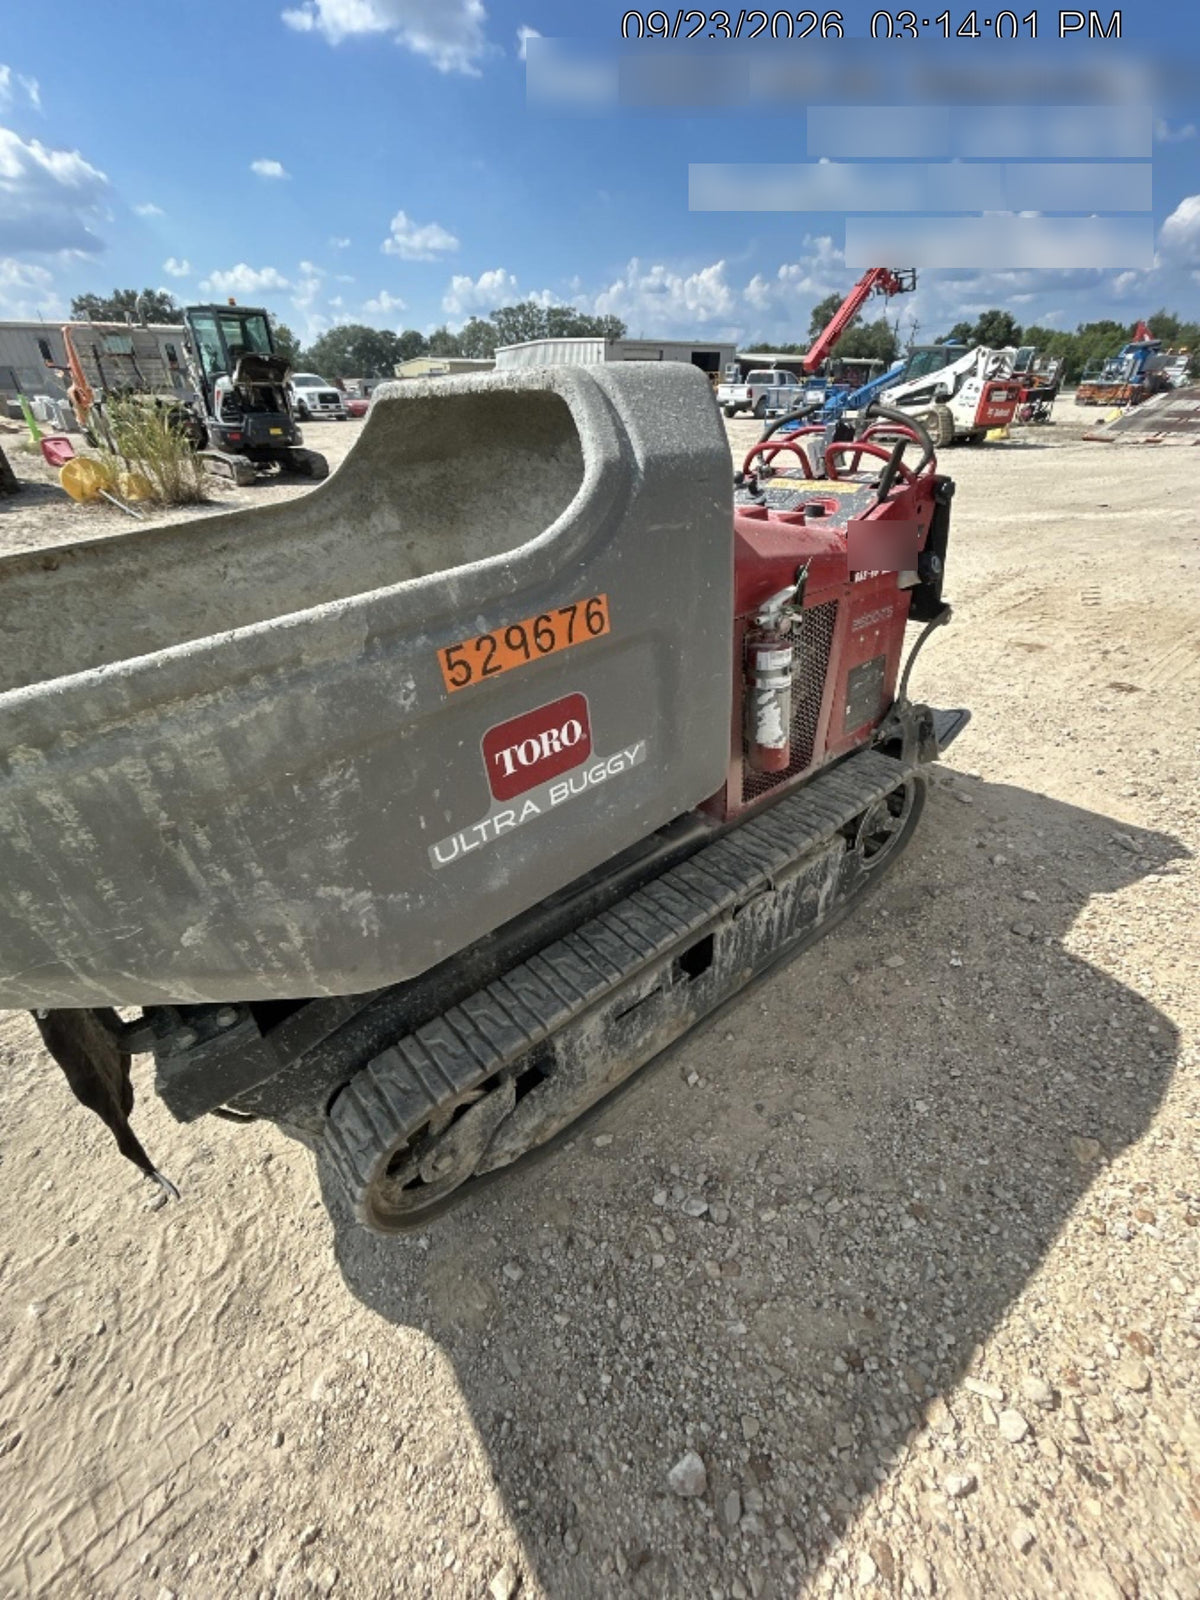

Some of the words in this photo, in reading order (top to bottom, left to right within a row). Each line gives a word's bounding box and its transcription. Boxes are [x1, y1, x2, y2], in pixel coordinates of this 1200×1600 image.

[445, 598, 605, 687] 529676
[495, 719, 582, 778] TORO
[433, 800, 541, 863] ULTRA
[549, 743, 641, 807] BUGGY
